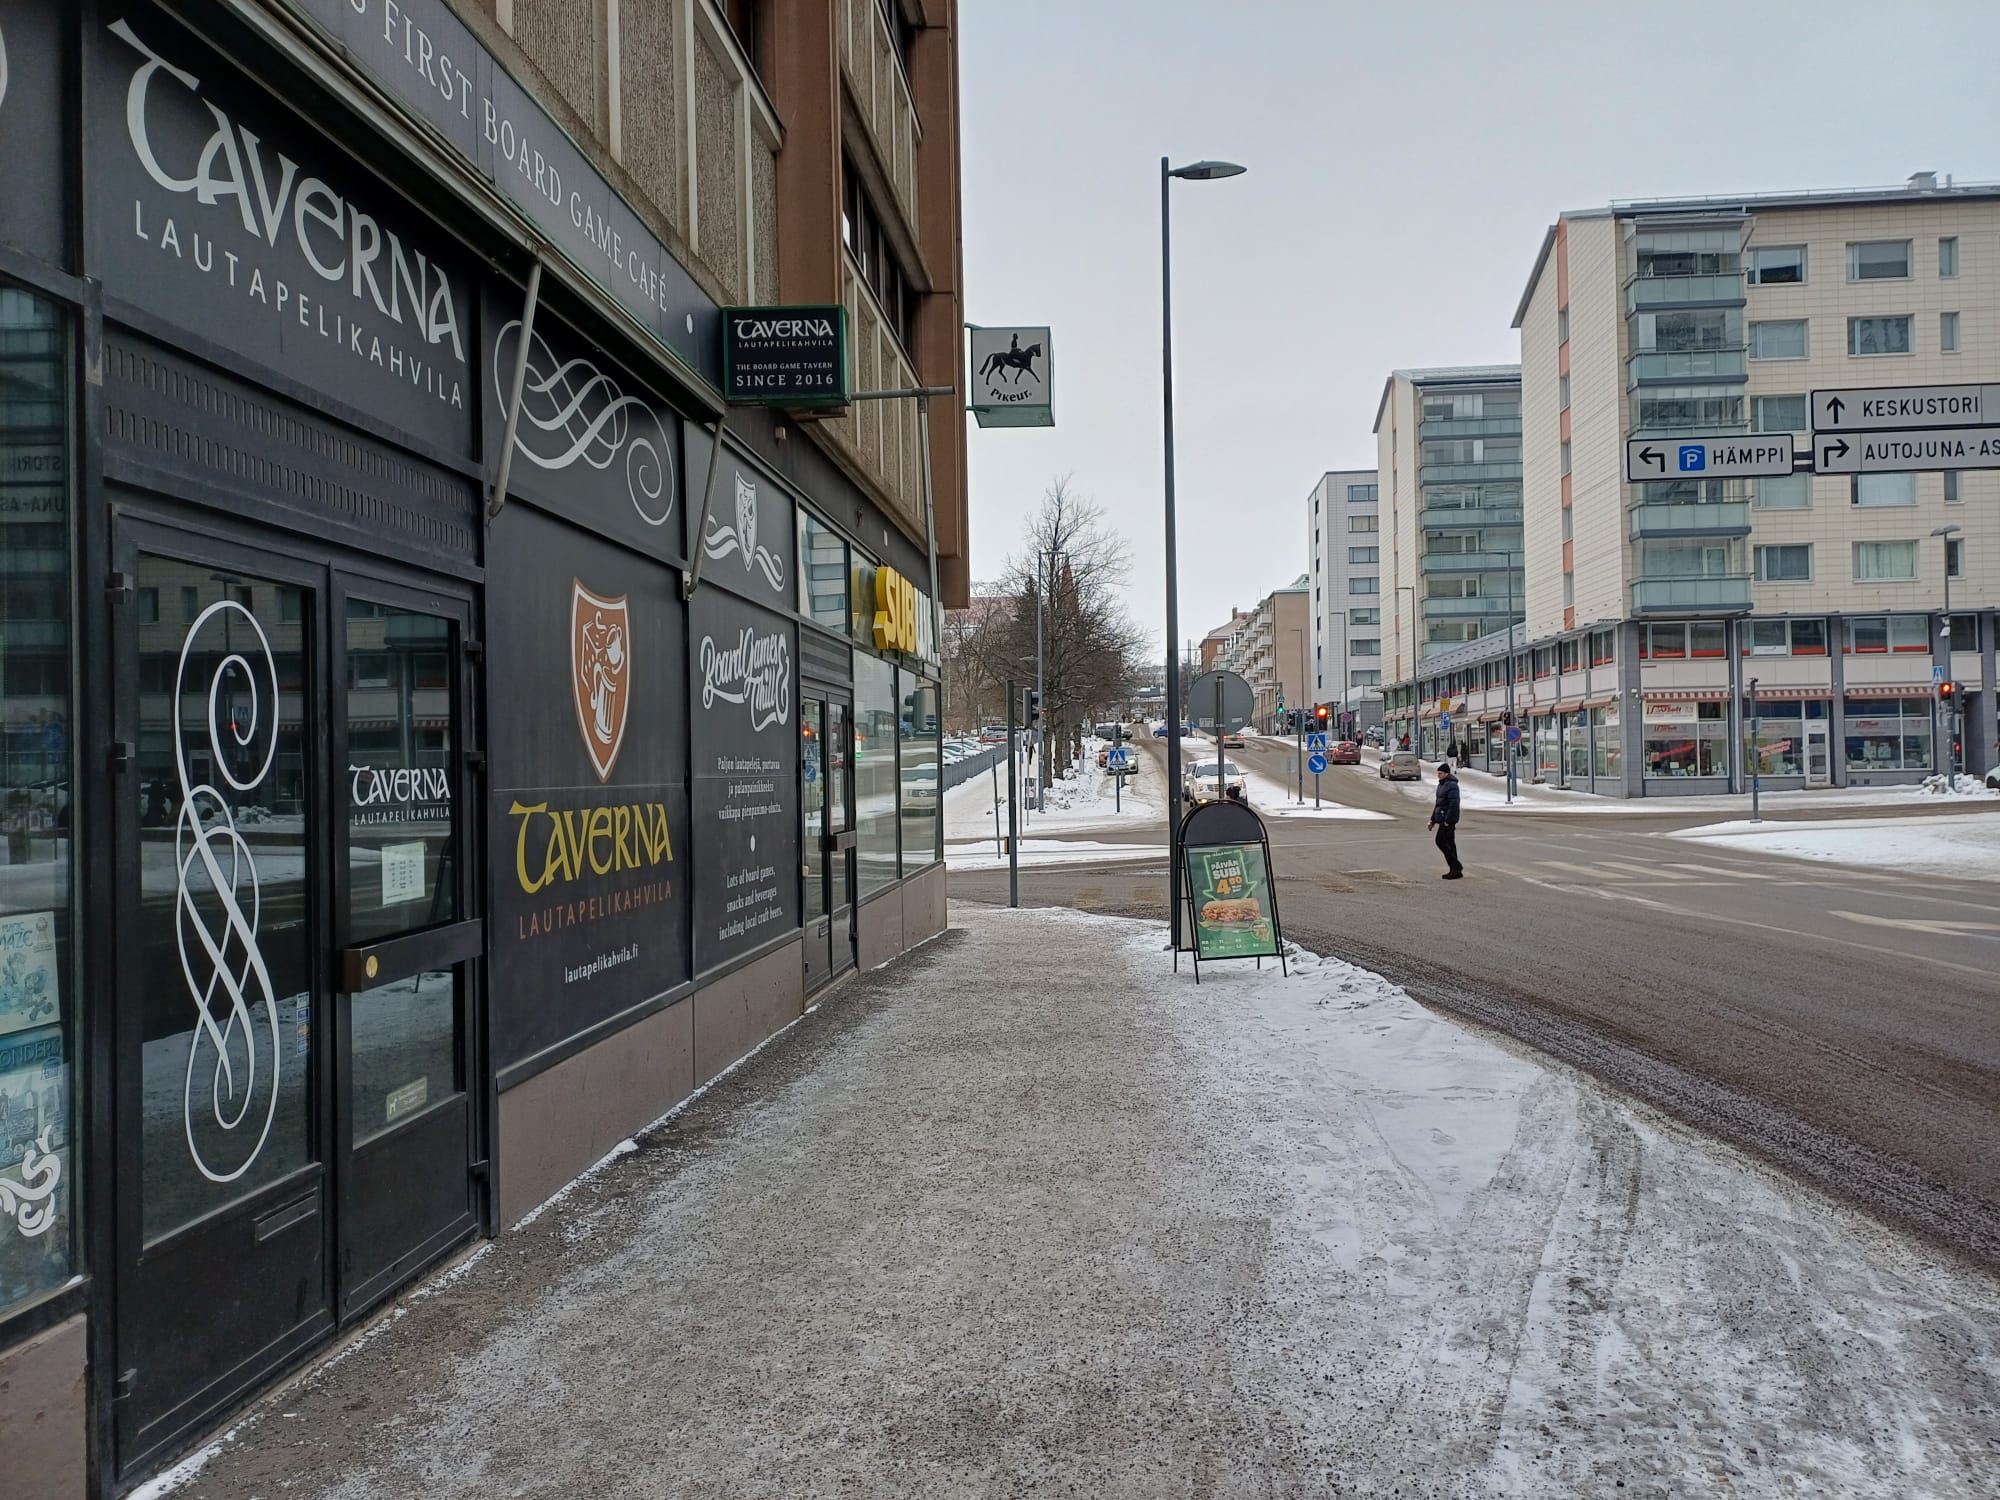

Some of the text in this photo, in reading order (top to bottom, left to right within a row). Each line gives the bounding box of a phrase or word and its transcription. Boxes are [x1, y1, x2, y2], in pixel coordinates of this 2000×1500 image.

[384, 0, 668, 312] FIRST BOARD GAME CAFÉ
[135, 200, 462, 409] LAUTAPELIKAHVILA
[738, 339, 833, 349] LAUTAPELIKAHVILA
[736, 363, 751, 371] THE
[780, 362, 801, 370] GAME
[736, 373, 833, 387] SINCE 2016
[1863, 396, 1979, 417] KESKUSTORI
[1686, 447, 1784, 469] P HÄMPPI
[1865, 439, 2000, 461] AUTOJUNA-AS
[700, 629, 744, 709] Board
[742, 627, 778, 679] Games
[354, 806, 450, 825] LAUTAPELIKAHVILA
[1211, 859, 1239, 870] PÄIVÄN
[1212, 866, 1241, 880] SUBI
[727, 865, 776, 889] Lots of board games,
[519, 880, 672, 940] LAUTAPELIKAHVILA
[727, 886, 777, 913] snacks and beverages
[719, 919, 745, 941] including
[745, 911, 757, 930] local
[758, 906, 769, 925] craft
[565, 943, 638, 984] lautapelikahvila.fi
